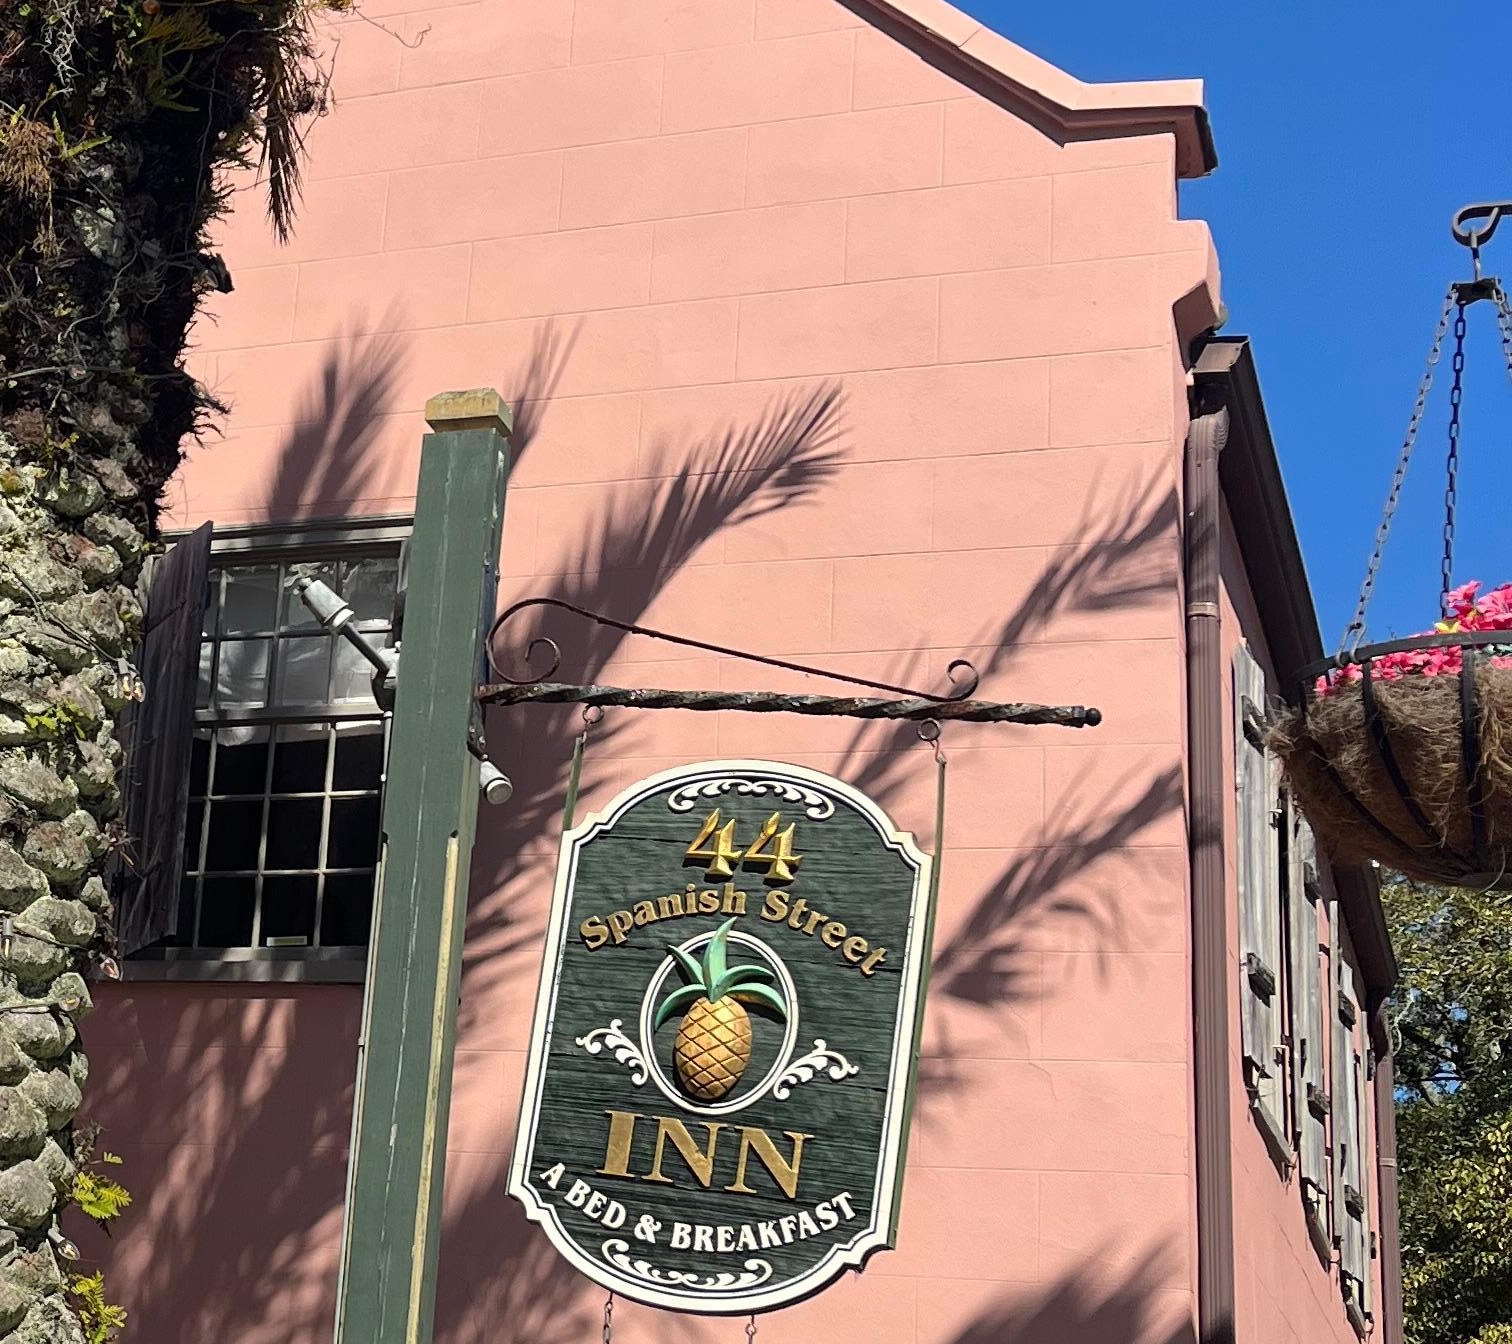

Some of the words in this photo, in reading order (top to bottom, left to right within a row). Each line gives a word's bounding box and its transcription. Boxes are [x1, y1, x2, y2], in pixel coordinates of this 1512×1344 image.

[685, 807, 804, 880] 44
[579, 882, 747, 950] Spanish
[759, 889, 887, 976] Street
[595, 1109, 816, 1199] INN
[539, 1162, 566, 1190] A
[563, 1178, 628, 1230] BED
[633, 1214, 662, 1244] &
[669, 1191, 857, 1253] BREAKFAST
